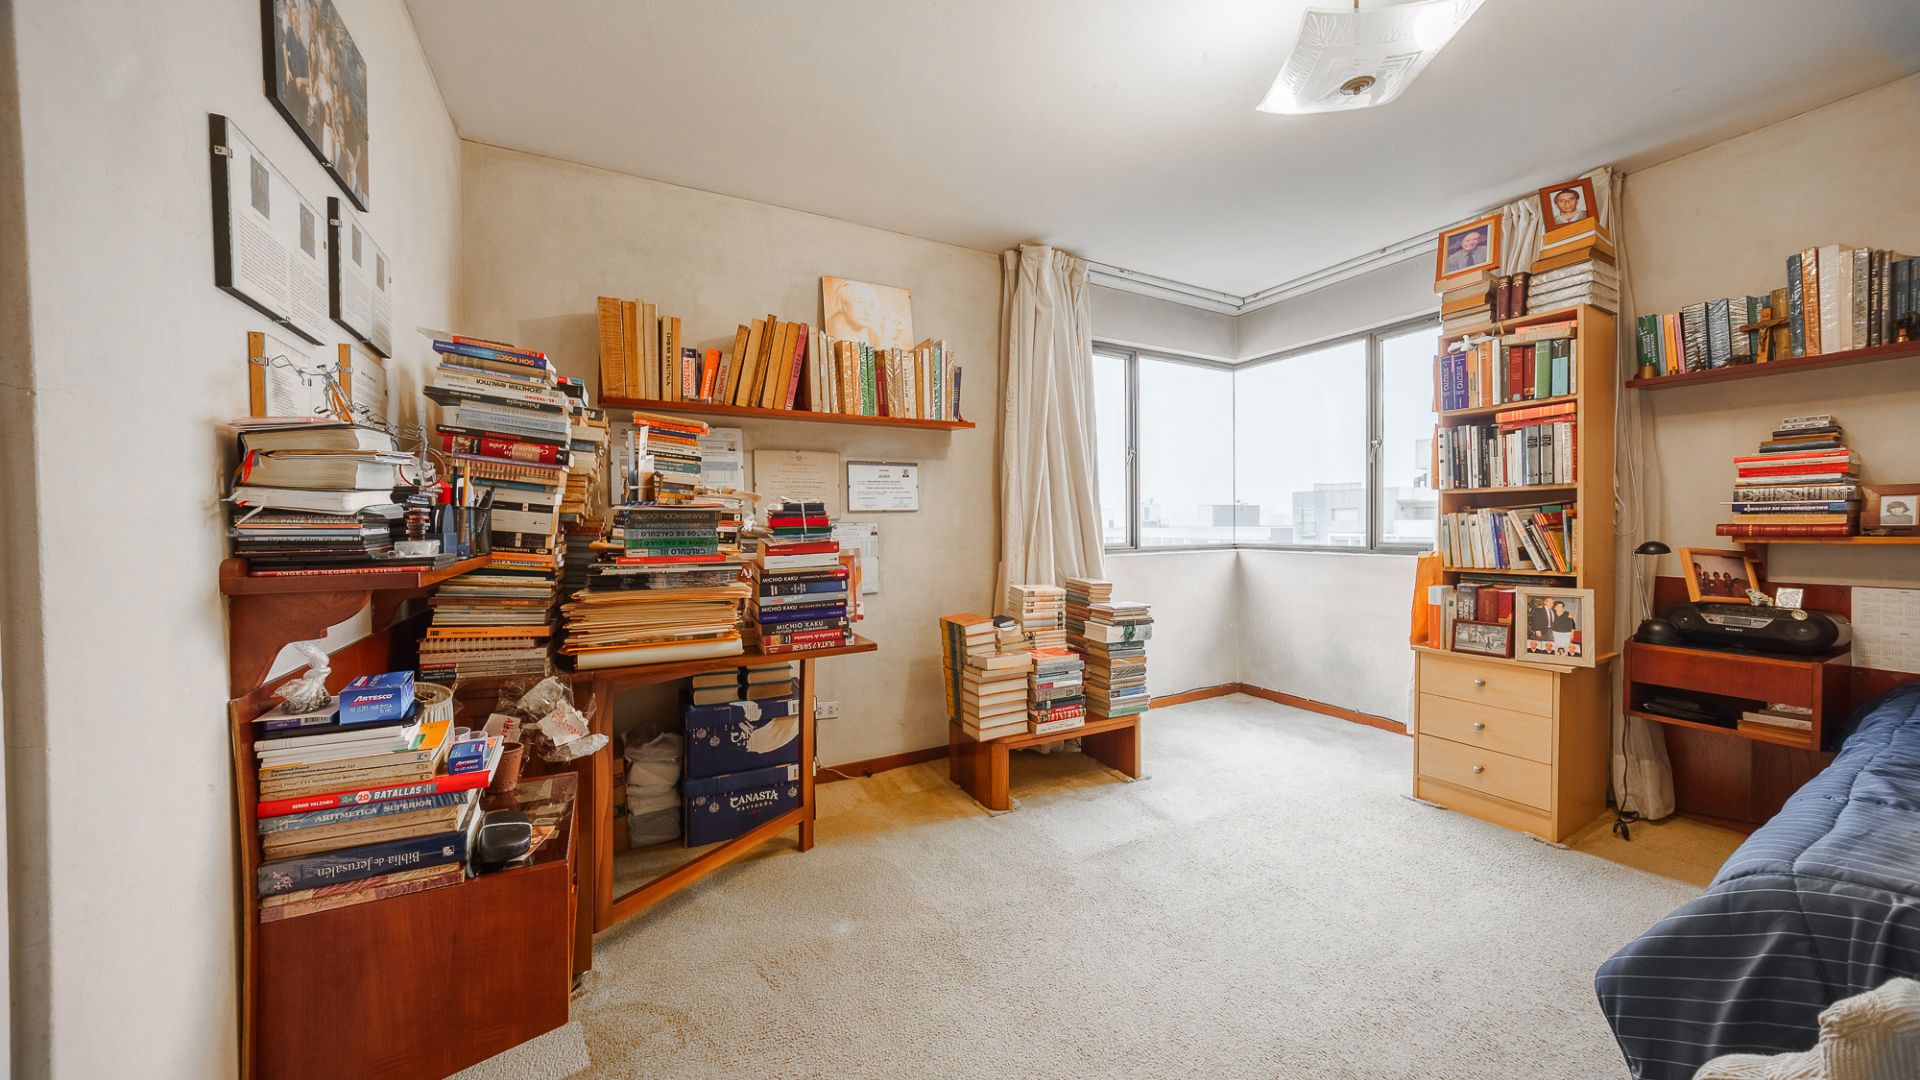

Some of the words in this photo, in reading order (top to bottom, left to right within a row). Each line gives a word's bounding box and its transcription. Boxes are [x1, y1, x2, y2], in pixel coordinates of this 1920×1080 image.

[495, 353, 517, 364] BOSCO
[518, 357, 535, 366] DON
[683, 359, 691, 395] GEOMETRIA
[761, 605, 782, 613] MICHIO
[776, 622, 803, 631] MICHIO
[805, 620, 824, 628] KAKU
[353, 693, 393, 702] ARTESCO
[357, 793, 369, 802] 20
[373, 785, 422, 800] BATALLAS
[729, 789, 779, 809] CANASTA
[314, 807, 378, 823] ARITMETICA
[383, 798, 432, 813] SUPERIOR
[374, 856, 387, 865] de
[387, 850, 420, 865] Biblia
[317, 855, 372, 877] Jerusalén
